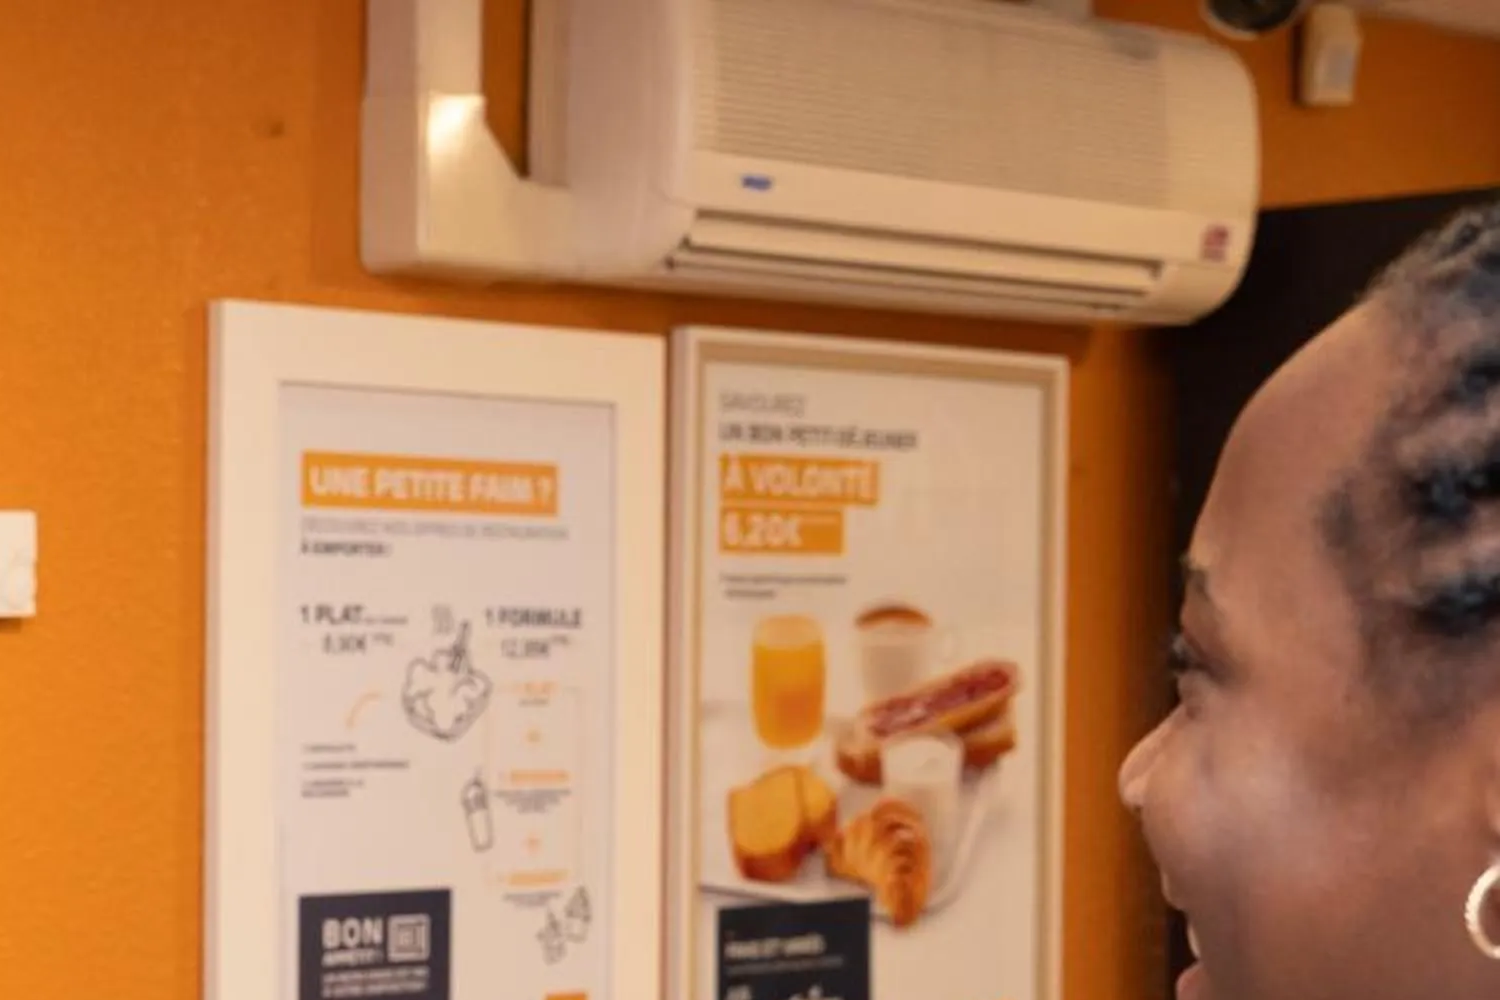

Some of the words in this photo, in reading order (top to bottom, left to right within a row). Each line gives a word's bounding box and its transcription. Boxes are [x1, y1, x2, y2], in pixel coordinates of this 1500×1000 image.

[309, 463, 369, 497] UNE
[374, 467, 465, 502] PETITE
[314, 604, 366, 626] PLAT
[321, 916, 383, 950] BON
